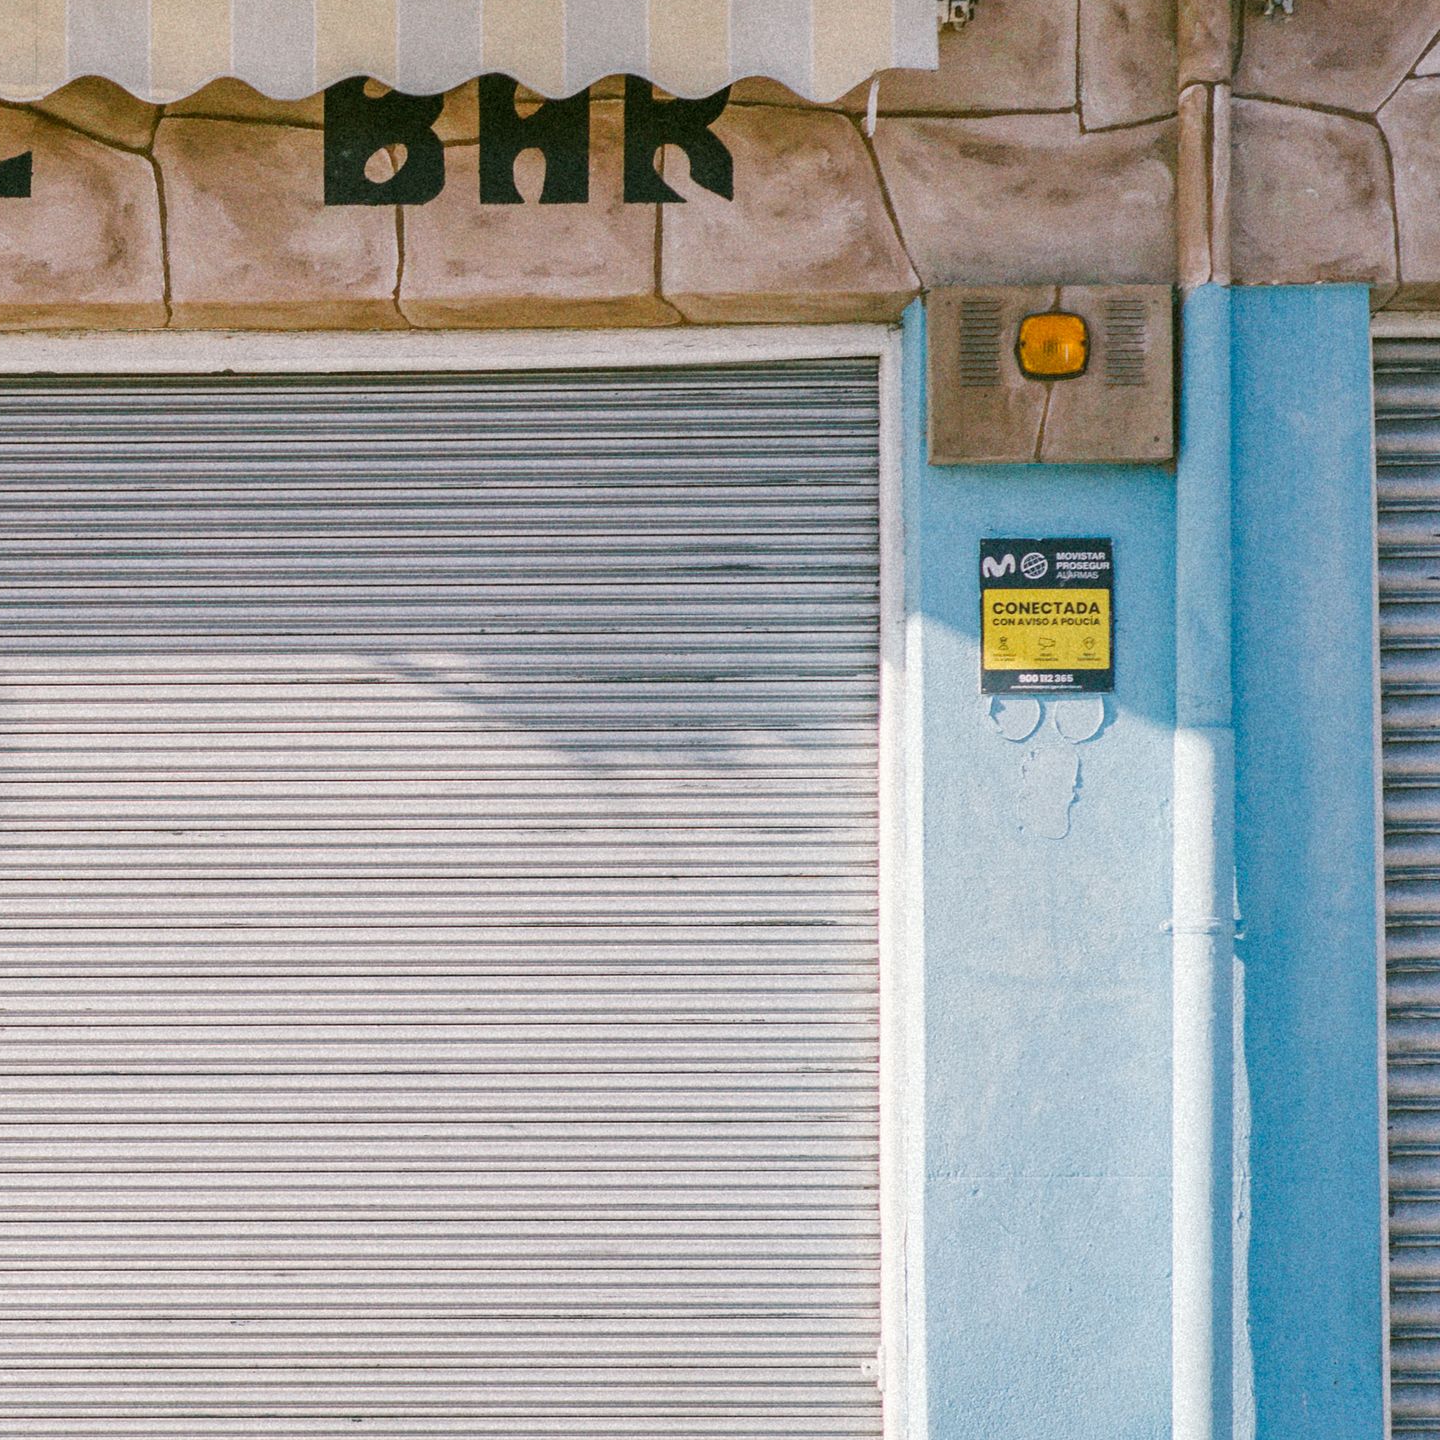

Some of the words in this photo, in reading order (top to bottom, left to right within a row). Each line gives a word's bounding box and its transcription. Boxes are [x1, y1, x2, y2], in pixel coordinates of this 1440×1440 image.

[324, 73, 734, 205] BAR
[1056, 552, 1106, 561] MOVISTAR
[1056, 561, 1110, 570] PROSEGUR
[1055, 570, 1100, 580] ALARMAS
[992, 602, 1101, 615] CONECTADA
[992, 618, 1015, 626] CON
[1017, 618, 1050, 626] AVISO
[1051, 618, 1059, 626] A
[1060, 616, 1101, 626] POLICÍA
[1018, 673, 1039, 683] 900
[1039, 673, 1054, 683] 112
[1054, 673, 1074, 683] 365
